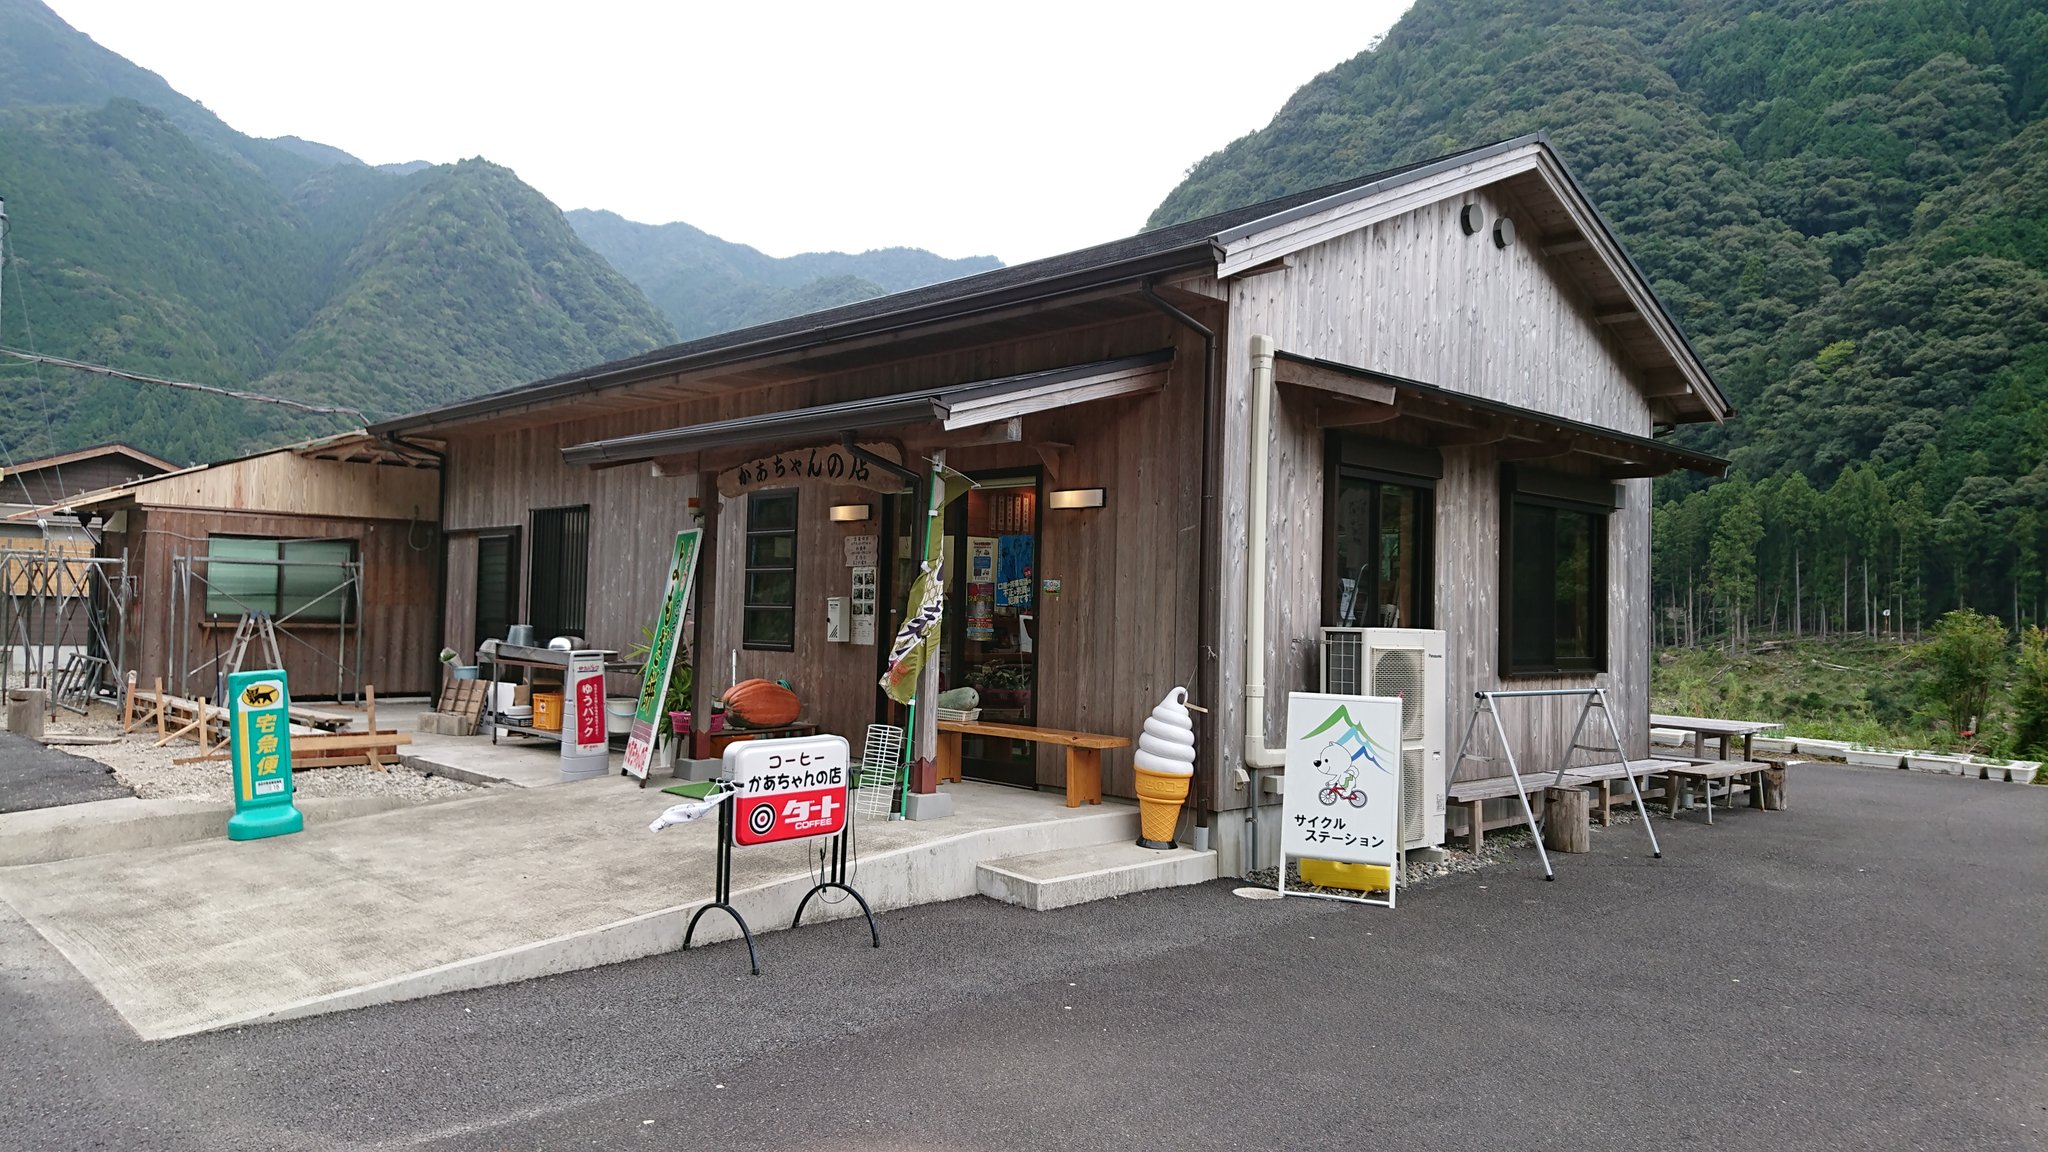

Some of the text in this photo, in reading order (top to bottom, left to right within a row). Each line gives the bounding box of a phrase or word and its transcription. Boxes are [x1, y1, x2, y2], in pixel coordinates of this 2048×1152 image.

[739, 449, 870, 486] かあちゃんの店
[581, 683, 594, 738] ゆうパック
[255, 713, 279, 776] 宅急便
[769, 752, 825, 769] コーヒー
[749, 767, 842, 793] かあちゃんの店
[781, 795, 840, 824] ダート
[1294, 813, 1347, 830] サイクル
[795, 817, 833, 830] COFFEE
[1305, 829, 1385, 849] ステーション
